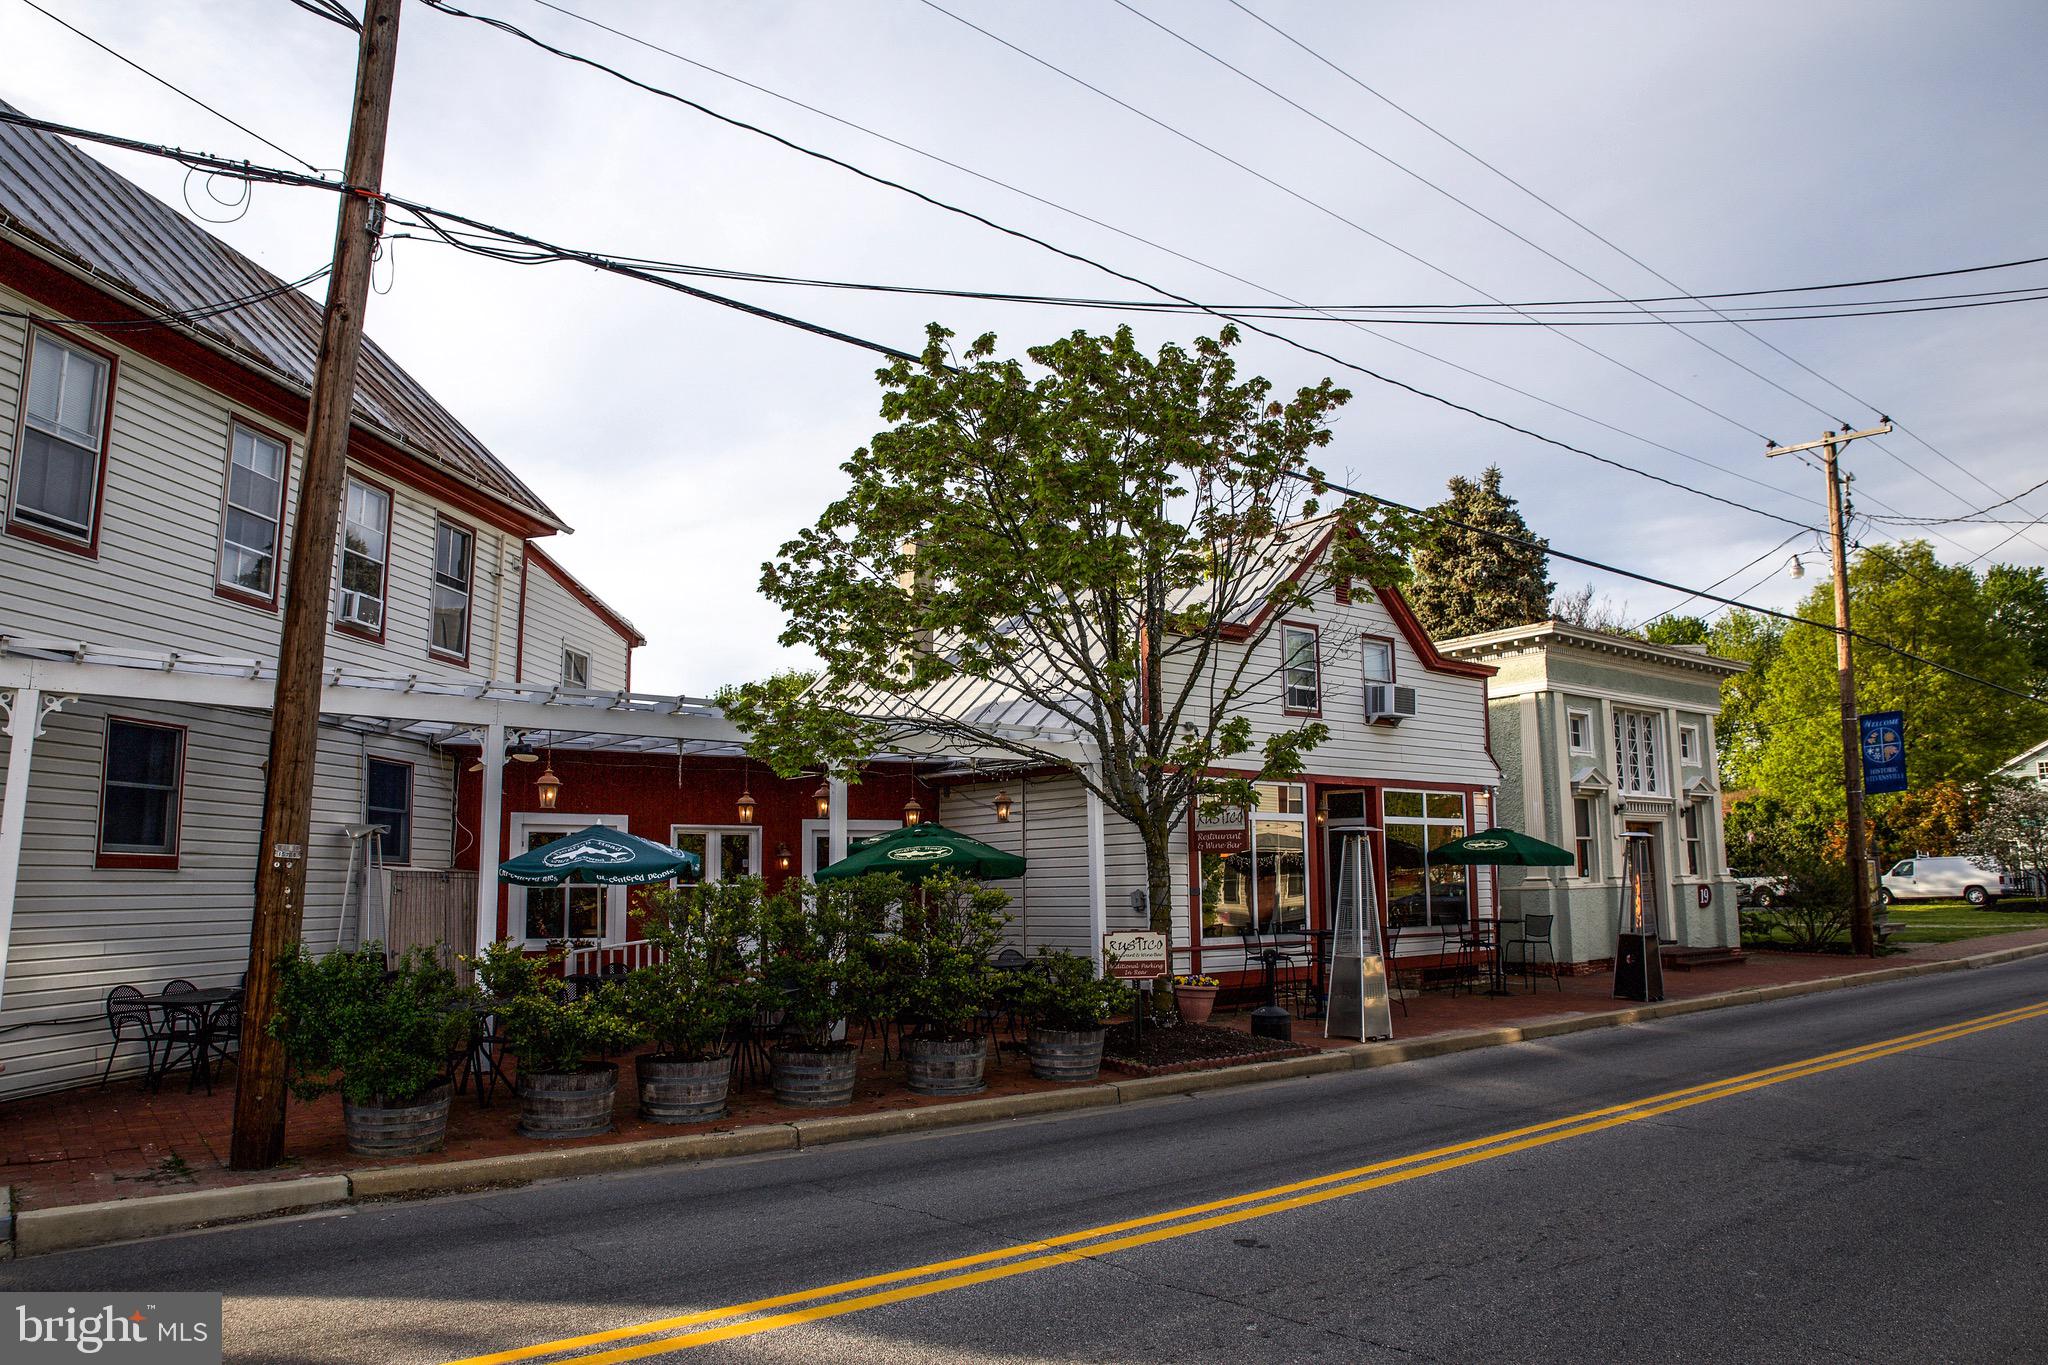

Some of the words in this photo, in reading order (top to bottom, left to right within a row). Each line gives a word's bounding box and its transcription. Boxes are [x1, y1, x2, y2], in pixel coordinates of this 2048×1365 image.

[1864, 719, 1899, 728] WELCOME
[1198, 832, 1243, 840] Restaurant
[1226, 841, 1243, 849] Bar
[1700, 888, 1709, 903] 19
[1109, 937, 1163, 951] RUSTICO
